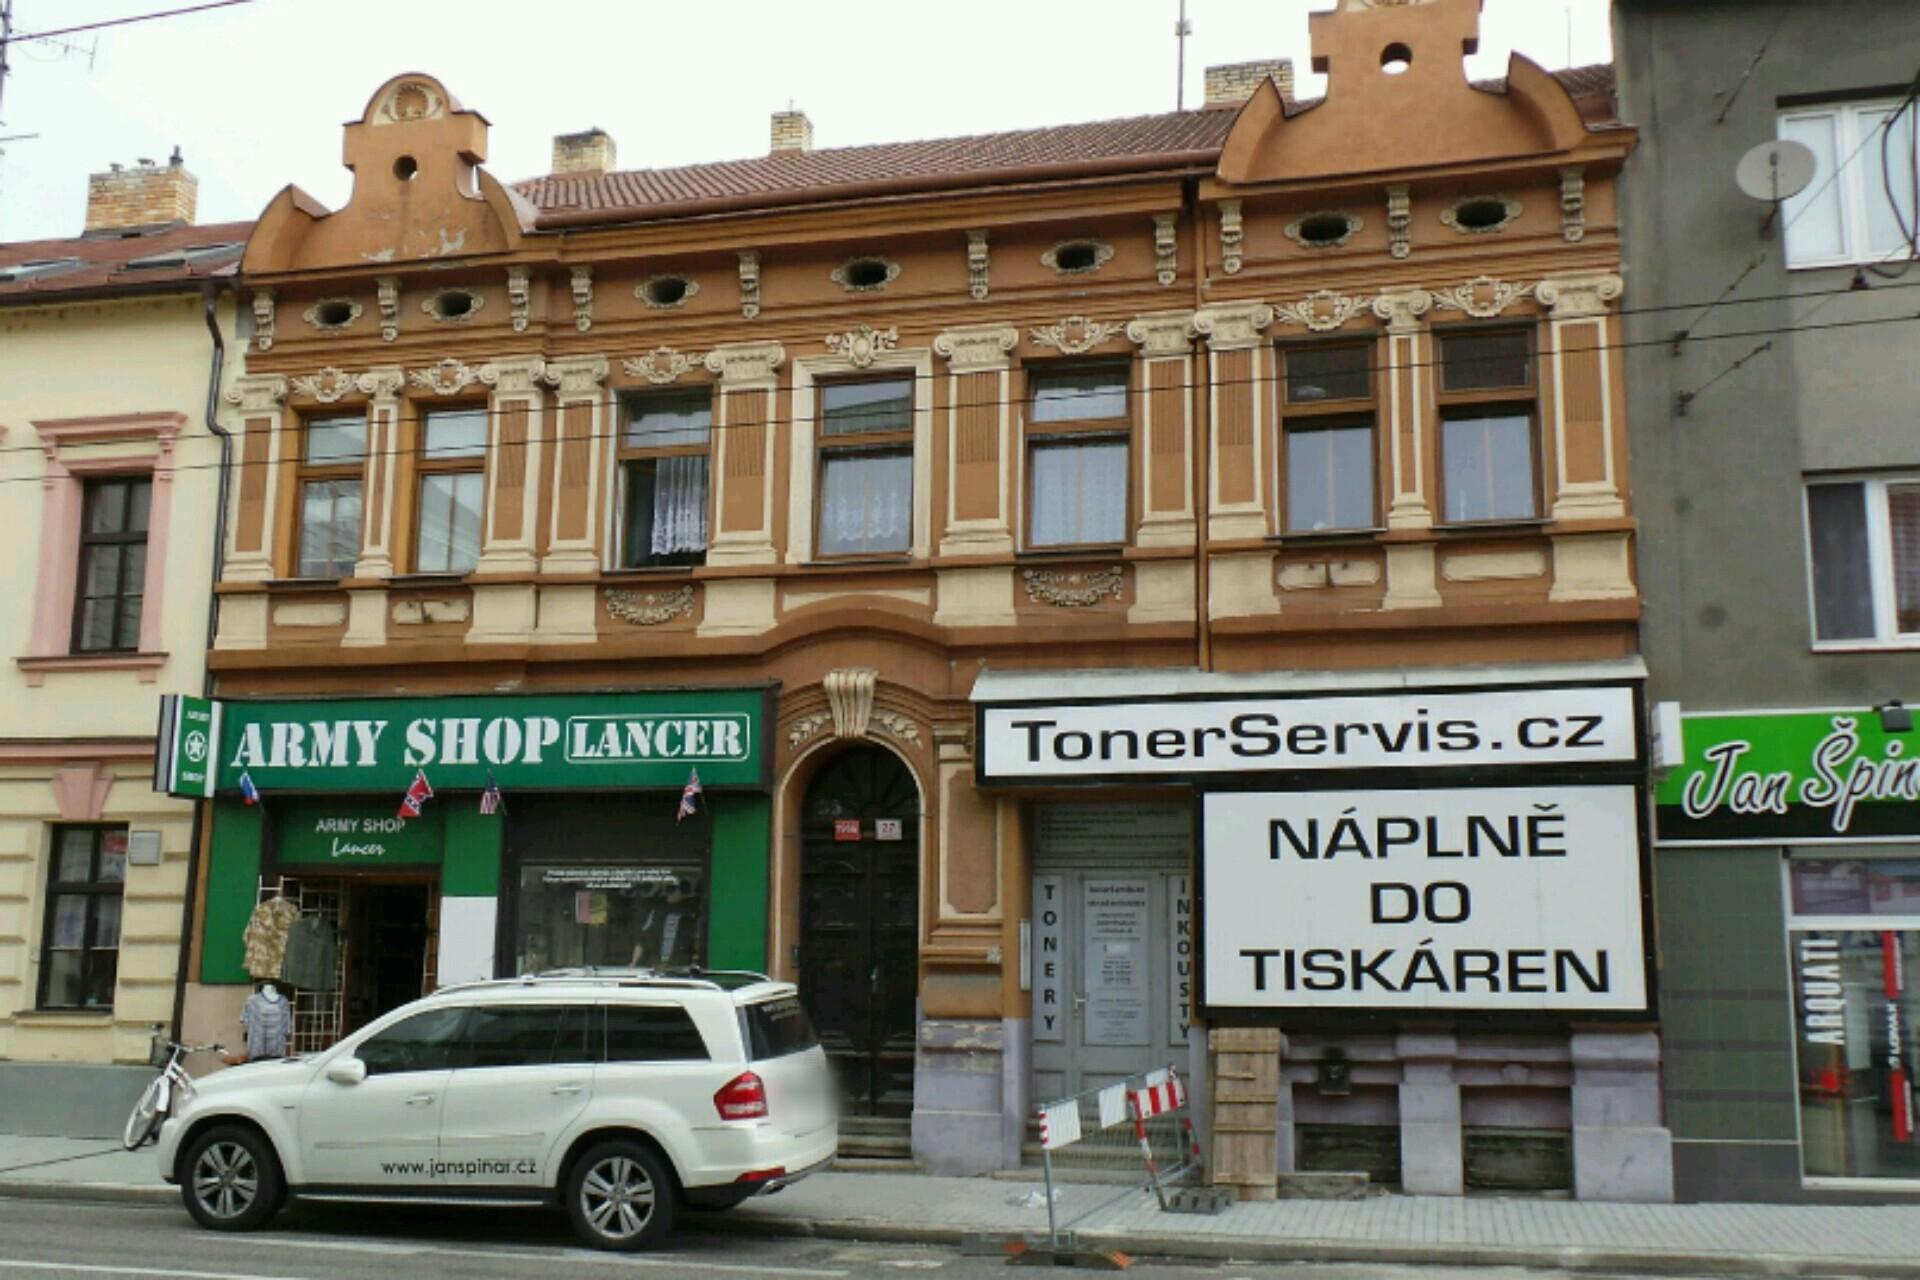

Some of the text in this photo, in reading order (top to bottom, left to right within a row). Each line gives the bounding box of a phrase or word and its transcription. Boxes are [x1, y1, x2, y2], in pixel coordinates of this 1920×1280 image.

[230, 716, 744, 768] ARMY SHOP LANCER
[1011, 708, 1605, 763] TonerServis.cz
[1683, 716, 1920, 831] Jan Špin
[315, 817, 406, 833] ARMY SHOP
[331, 836, 386, 858] Lancer
[1268, 803, 1568, 860] NÁPLNĚ
[1370, 880, 1472, 925] DO
[1043, 884, 1058, 1031] TONERY
[1176, 879, 1191, 1039] INKOUSTY
[1238, 937, 1611, 994] TISKÁREN
[1801, 938, 1846, 1046] ARQUATI
[381, 1158, 537, 1178] www.janspinar.cz
